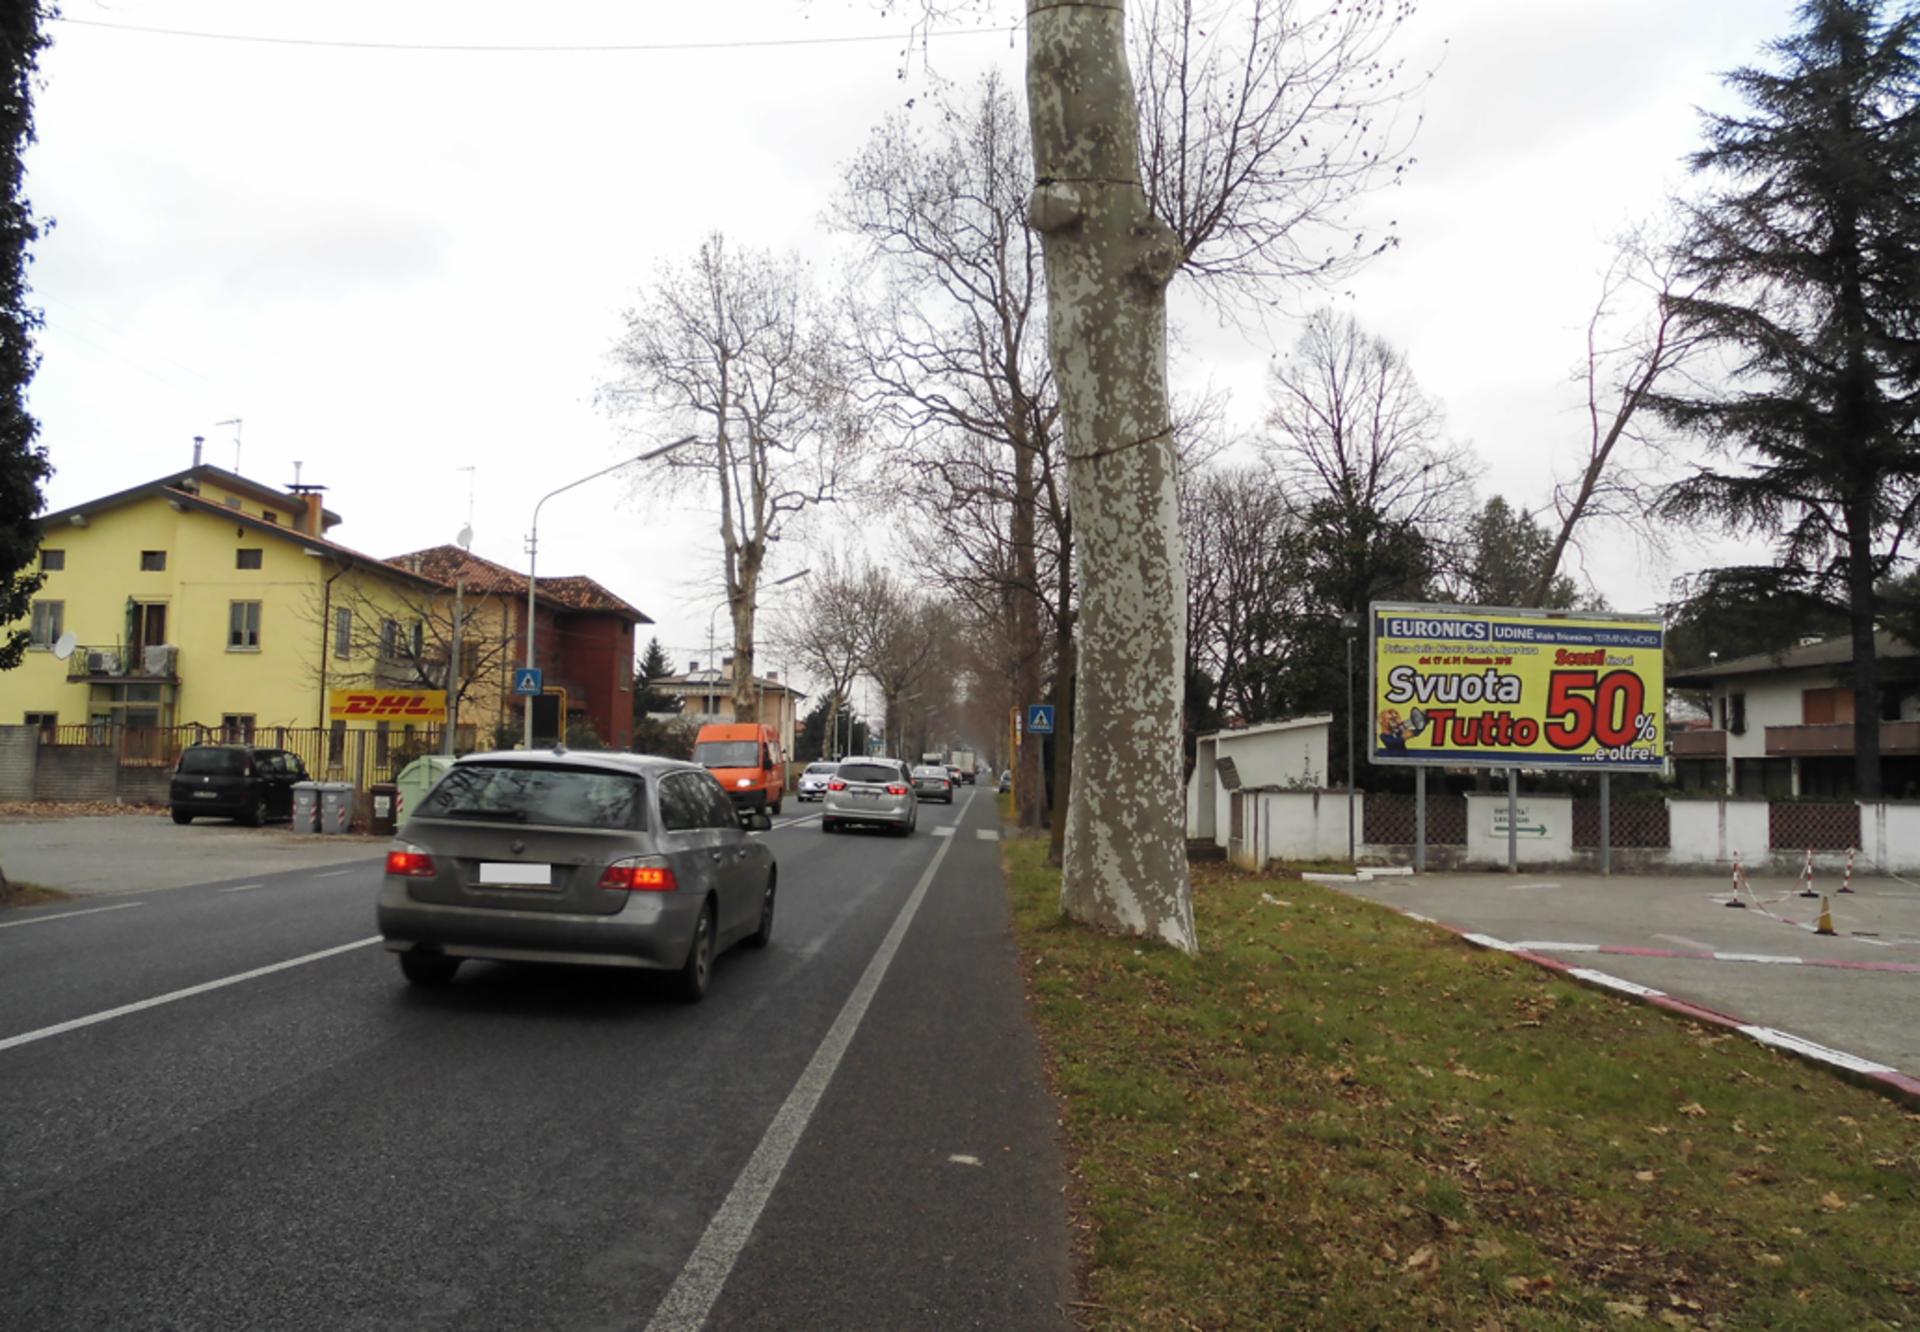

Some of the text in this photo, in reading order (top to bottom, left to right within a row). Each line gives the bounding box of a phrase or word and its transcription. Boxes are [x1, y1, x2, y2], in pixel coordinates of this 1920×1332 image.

[1391, 620, 1486, 639] EURONICS
[1494, 626, 1535, 640] UDINE
[1554, 648, 1606, 666] Sconti
[1384, 664, 1522, 704] Svuota
[344, 695, 431, 715] DHL
[1426, 708, 1539, 747] Tutto
[1609, 745, 1656, 761] oltre!
